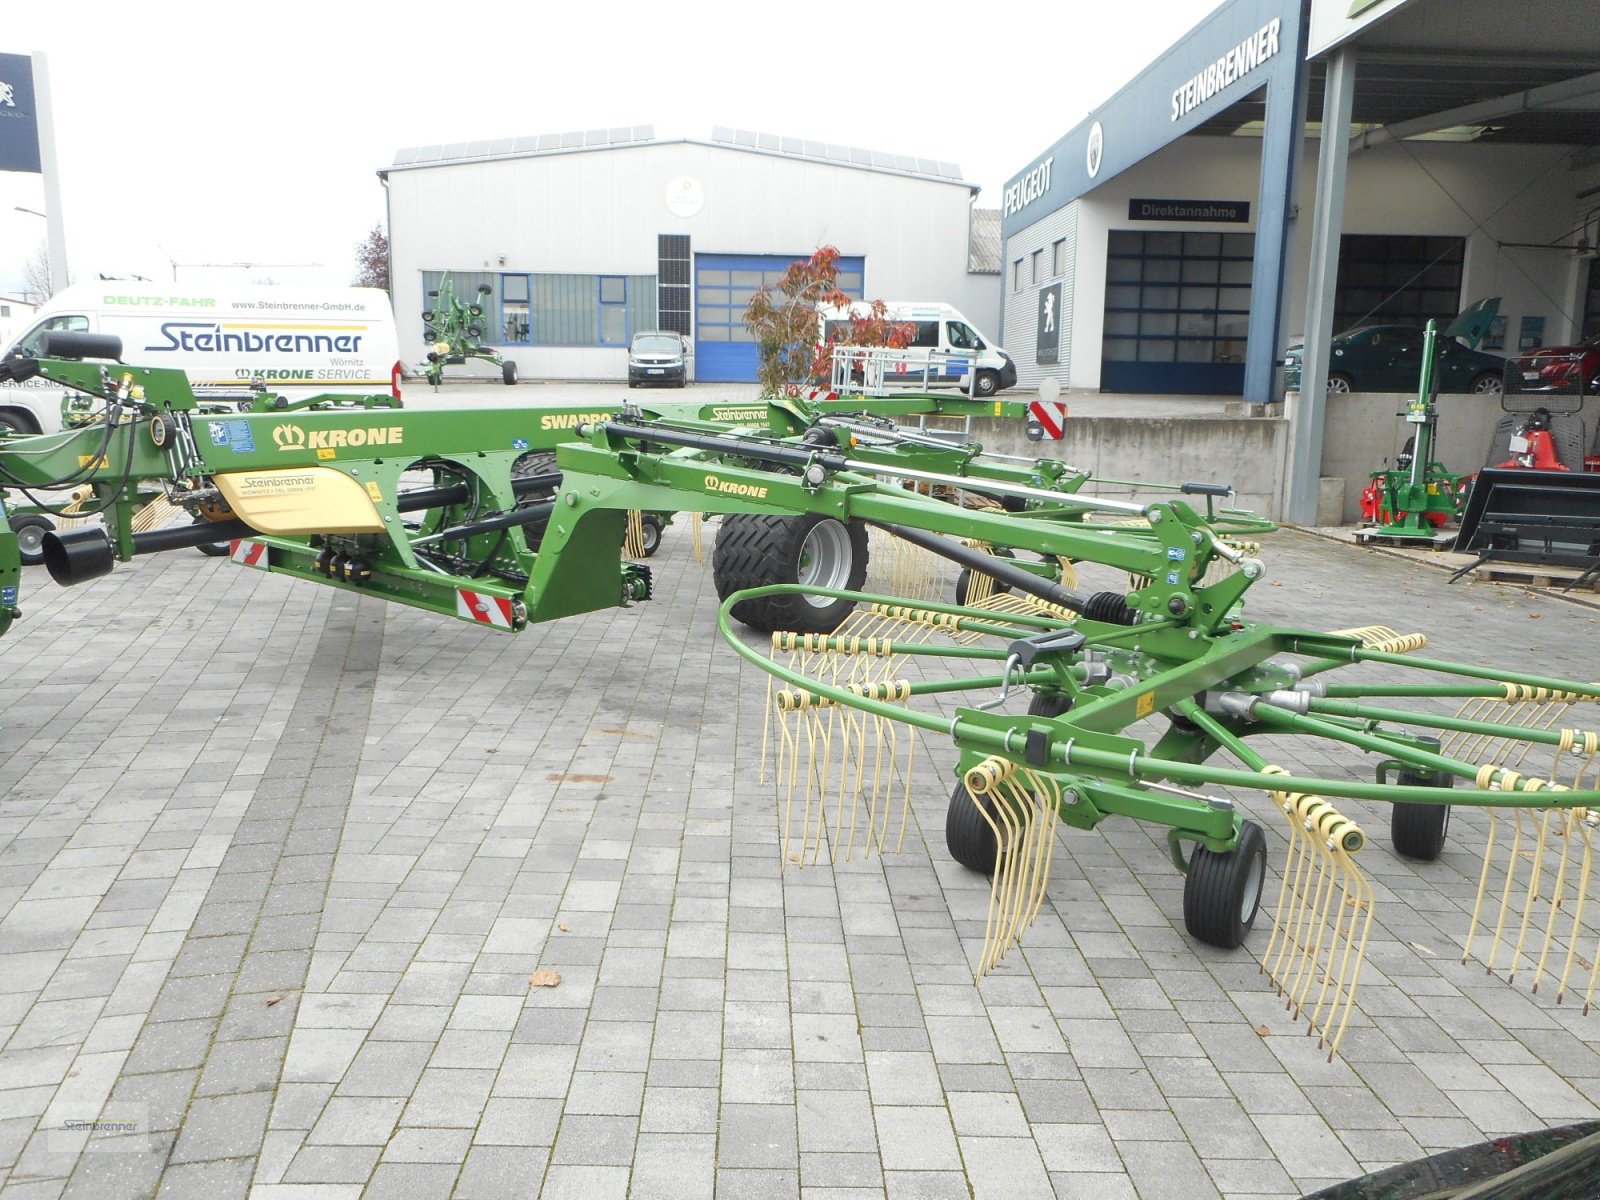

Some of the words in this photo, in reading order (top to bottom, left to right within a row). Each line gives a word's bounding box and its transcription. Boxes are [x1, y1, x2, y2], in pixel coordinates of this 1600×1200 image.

[1171, 17, 1281, 122] STEINBRENNER
[1004, 156, 1054, 219] PEUGEOT
[1142, 204, 1237, 218] Direktannahme
[103, 295, 216, 307] DEUTZ-FAHR
[231, 301, 366, 311] www.Steinbrenner-GmbH.de
[144, 322, 362, 354] Steinbrenner
[330, 357, 364, 366] Wörnitz
[253, 369, 314, 379] KRONE
[318, 369, 372, 379] SERVICE
[710, 406, 768, 421] Steinbrenner
[308, 427, 403, 449] KRONE
[240, 474, 315, 489] Steinbrenner
[718, 481, 768, 499] KRONE
